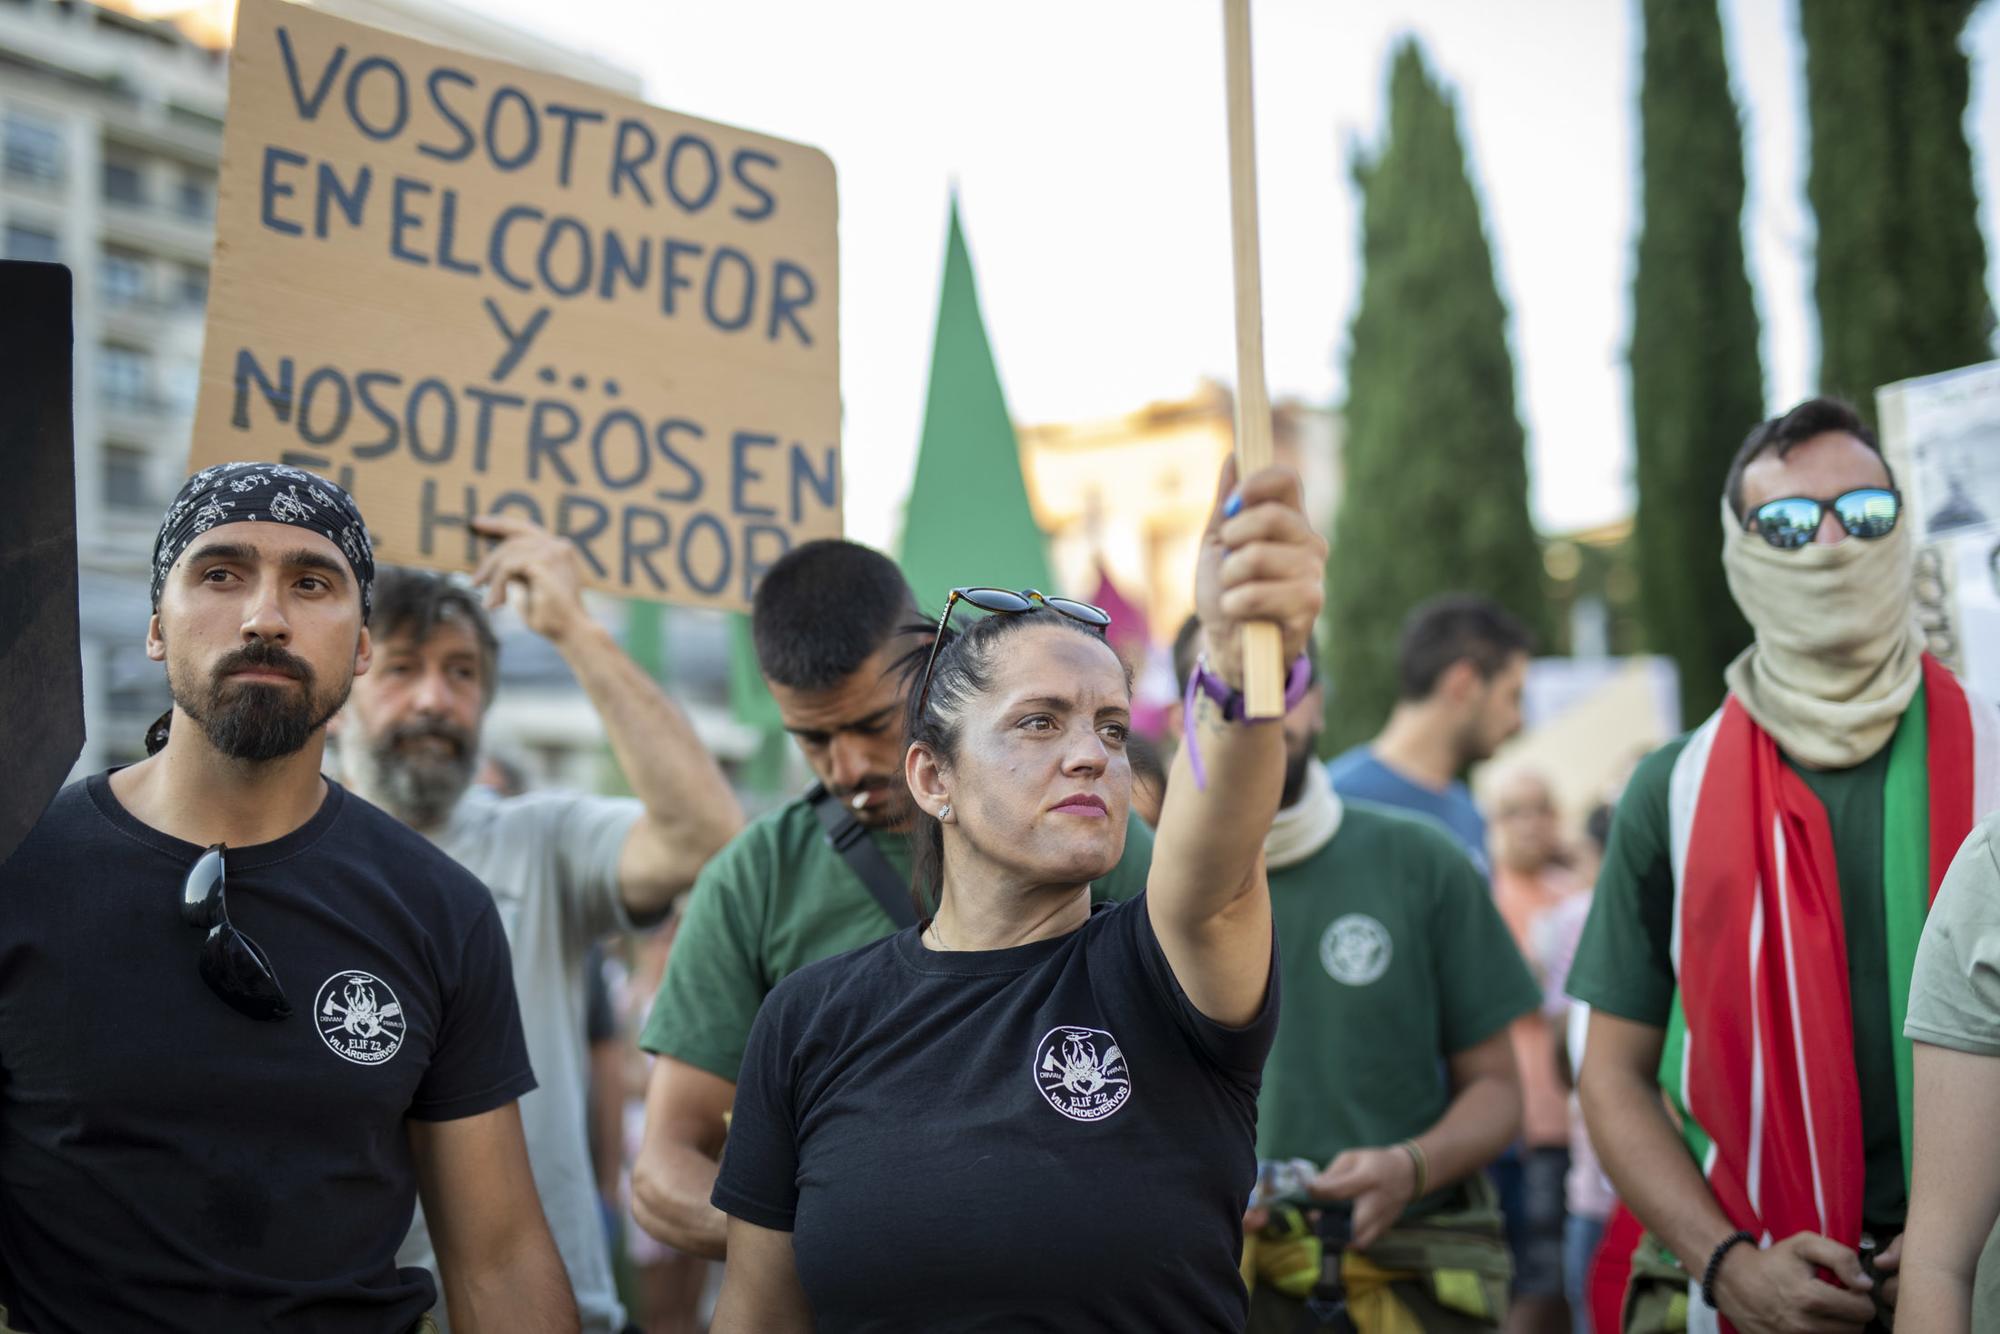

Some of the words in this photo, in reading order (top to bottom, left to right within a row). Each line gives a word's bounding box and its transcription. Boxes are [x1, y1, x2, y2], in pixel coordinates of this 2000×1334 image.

[276, 25, 782, 223] VOSOTROS
[260, 145, 373, 239] EN
[231, 347, 706, 504] NOSOTROS
[730, 432, 837, 525] EN
[329, 1035, 397, 1061] VILLARDECIERVOS
[348, 1038, 369, 1050] ELIF
[1050, 1086, 1128, 1118] VILLARDECIERVOS
[1070, 1096, 1092, 1107] ELIF
